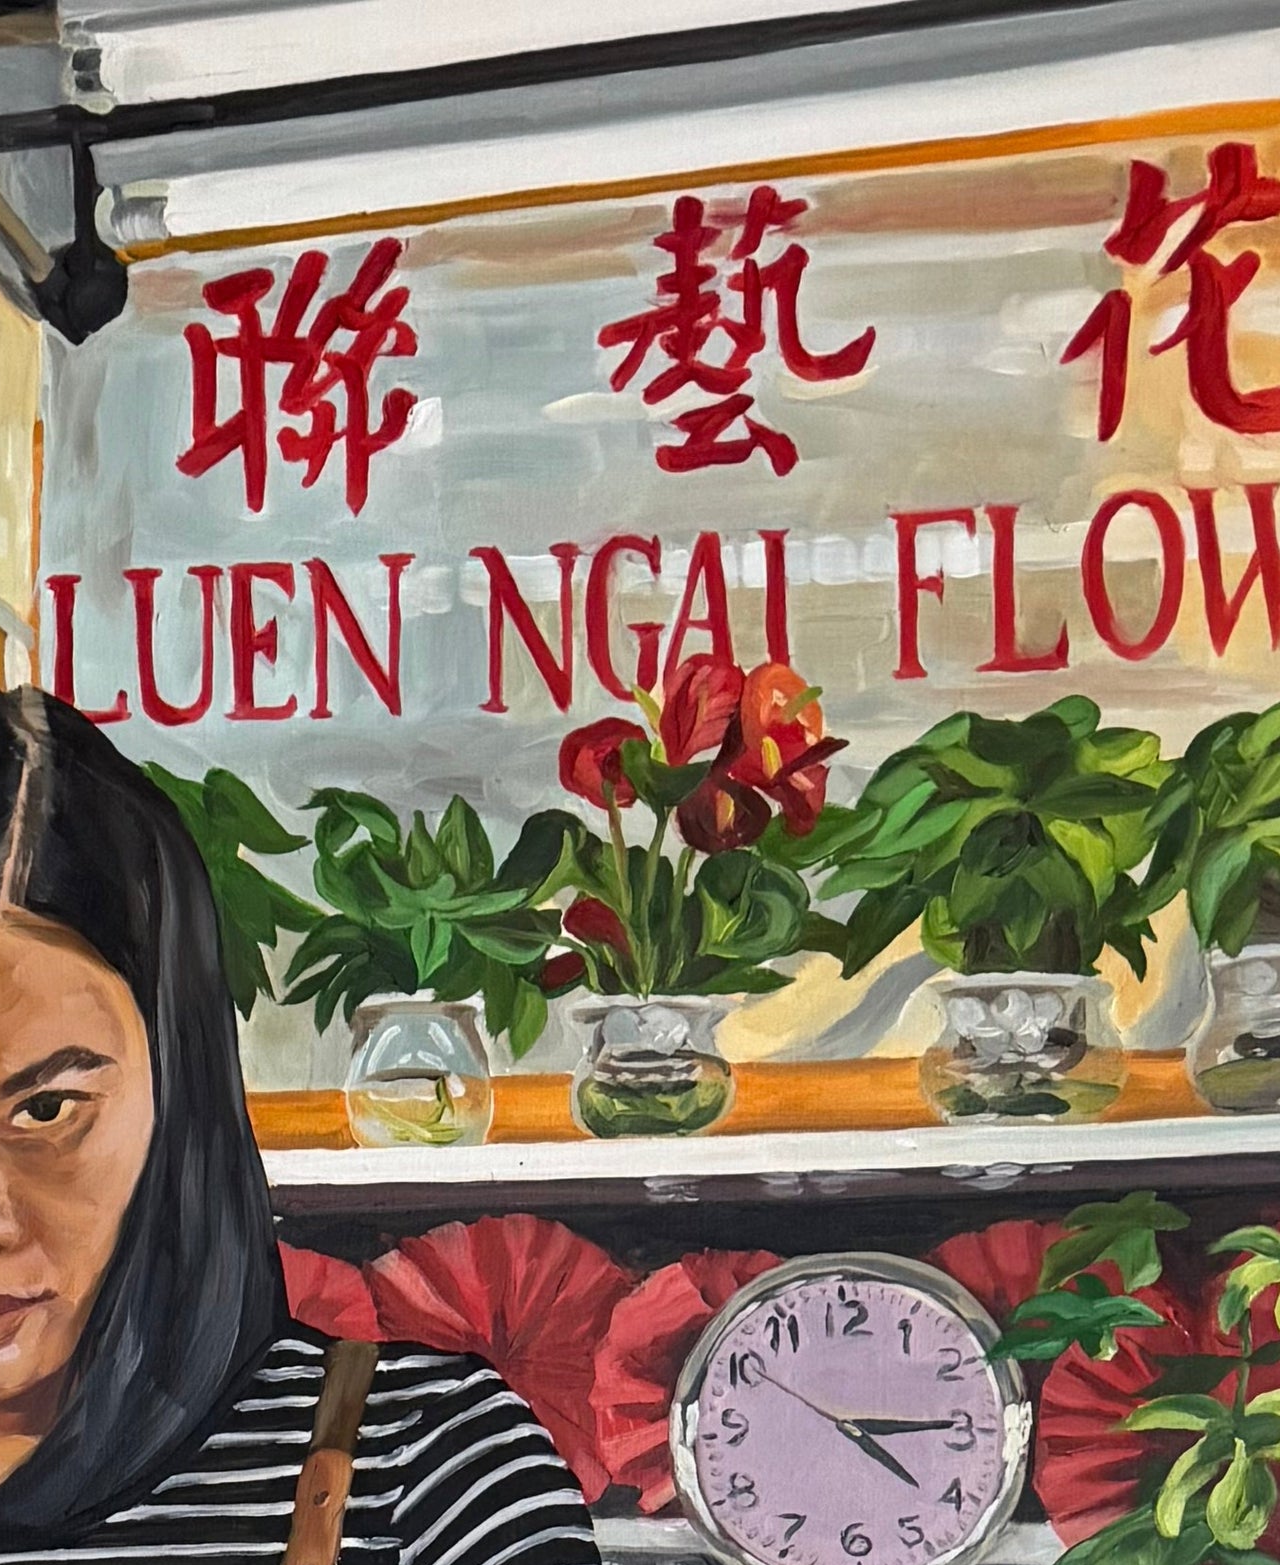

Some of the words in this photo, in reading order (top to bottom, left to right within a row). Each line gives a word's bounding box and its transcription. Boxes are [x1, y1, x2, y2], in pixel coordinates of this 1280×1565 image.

[45, 552, 418, 727] LUEN
[468, 528, 791, 713] NGAI
[890, 483, 1280, 679] FLOW
[764, 1313, 800, 1355] 11
[825, 1300, 874, 1338] 12
[897, 1318, 913, 1355] 1
[729, 1348, 767, 1389] 10
[936, 1347, 965, 1382] 2
[720, 1408, 750, 1447] 9
[943, 1409, 978, 1452] 3
[728, 1472, 760, 1509] 8
[939, 1477, 963, 1513] 4
[776, 1513, 807, 1543] 7
[840, 1522, 873, 1557] 6
[898, 1515, 925, 1548] 5
